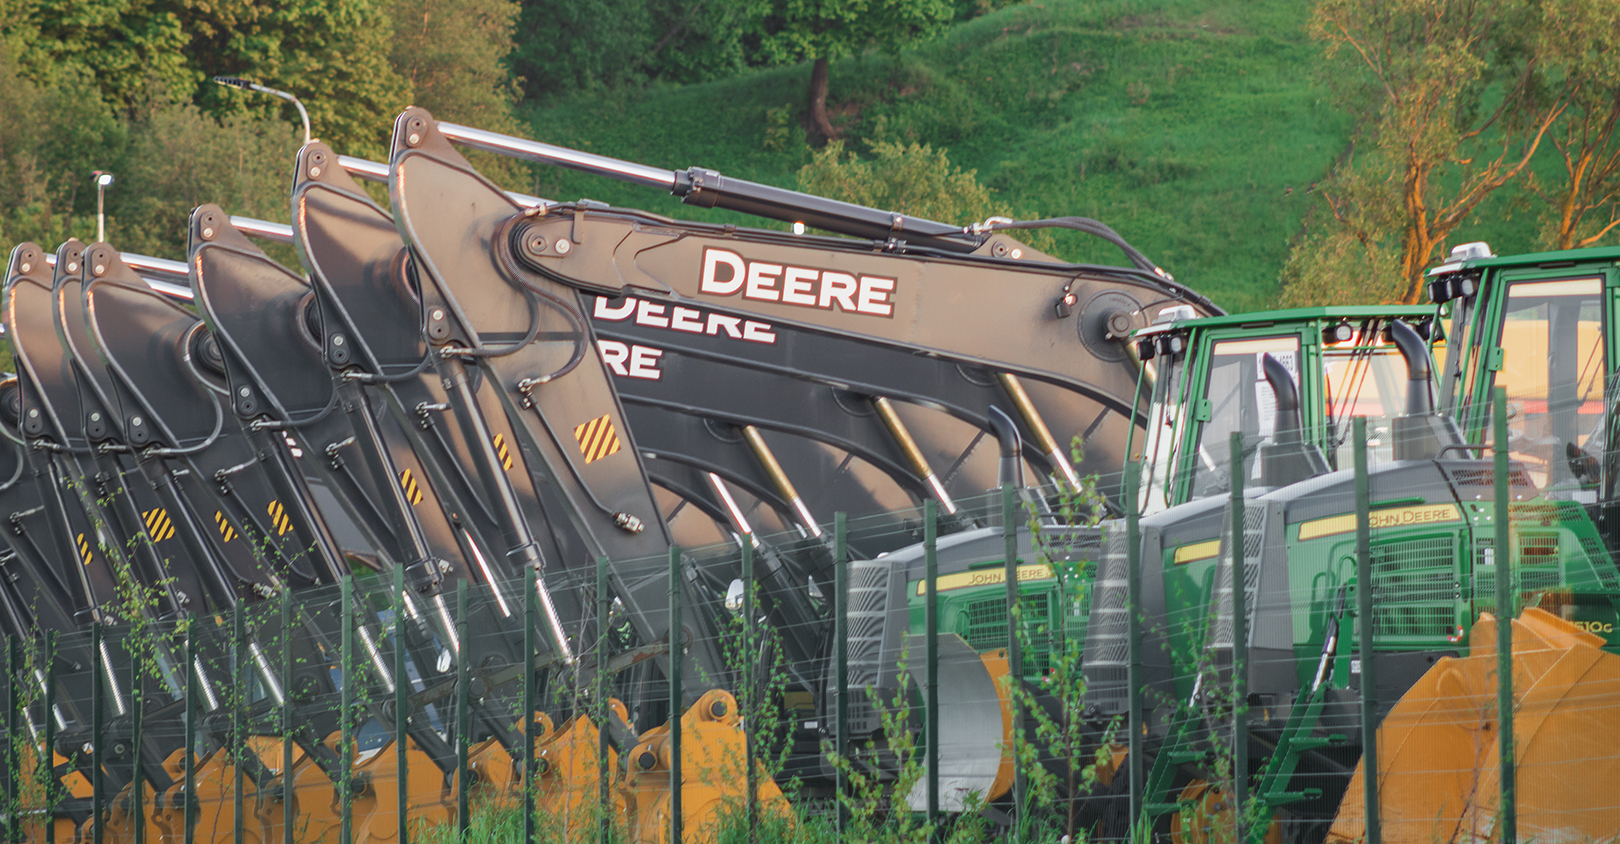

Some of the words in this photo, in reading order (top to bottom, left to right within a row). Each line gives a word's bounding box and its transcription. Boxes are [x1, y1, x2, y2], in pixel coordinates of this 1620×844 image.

[701, 248, 895, 315] DEERE
[593, 295, 777, 344] DEERE
[1368, 513, 1399, 527] OHN
[1403, 509, 1450, 522] DEERE
[967, 572, 1002, 585] JOHN
